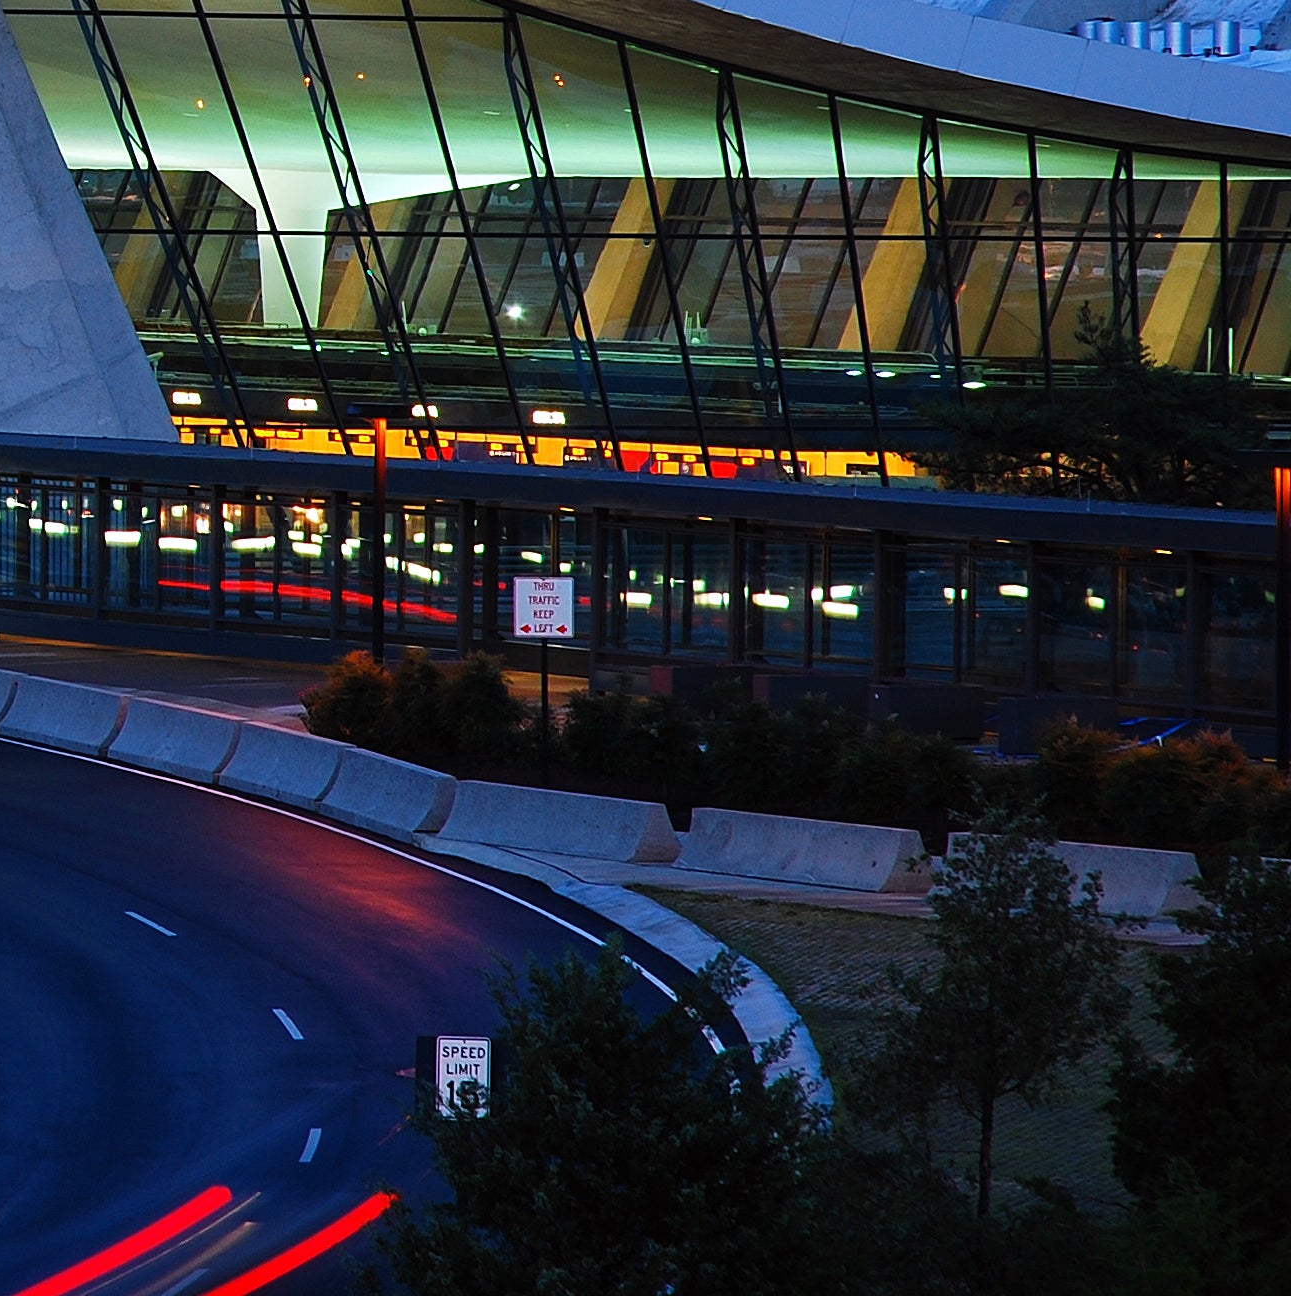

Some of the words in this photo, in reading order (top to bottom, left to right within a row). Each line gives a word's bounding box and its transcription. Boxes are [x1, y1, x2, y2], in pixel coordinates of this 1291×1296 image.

[533, 581, 555, 591] THRU
[528, 595, 560, 605] TRAFFIC
[533, 610, 555, 619] KEEP
[534, 624, 553, 633] LEFT
[442, 1046, 486, 1059] SPEED
[446, 1063, 480, 1075] LIMIT
